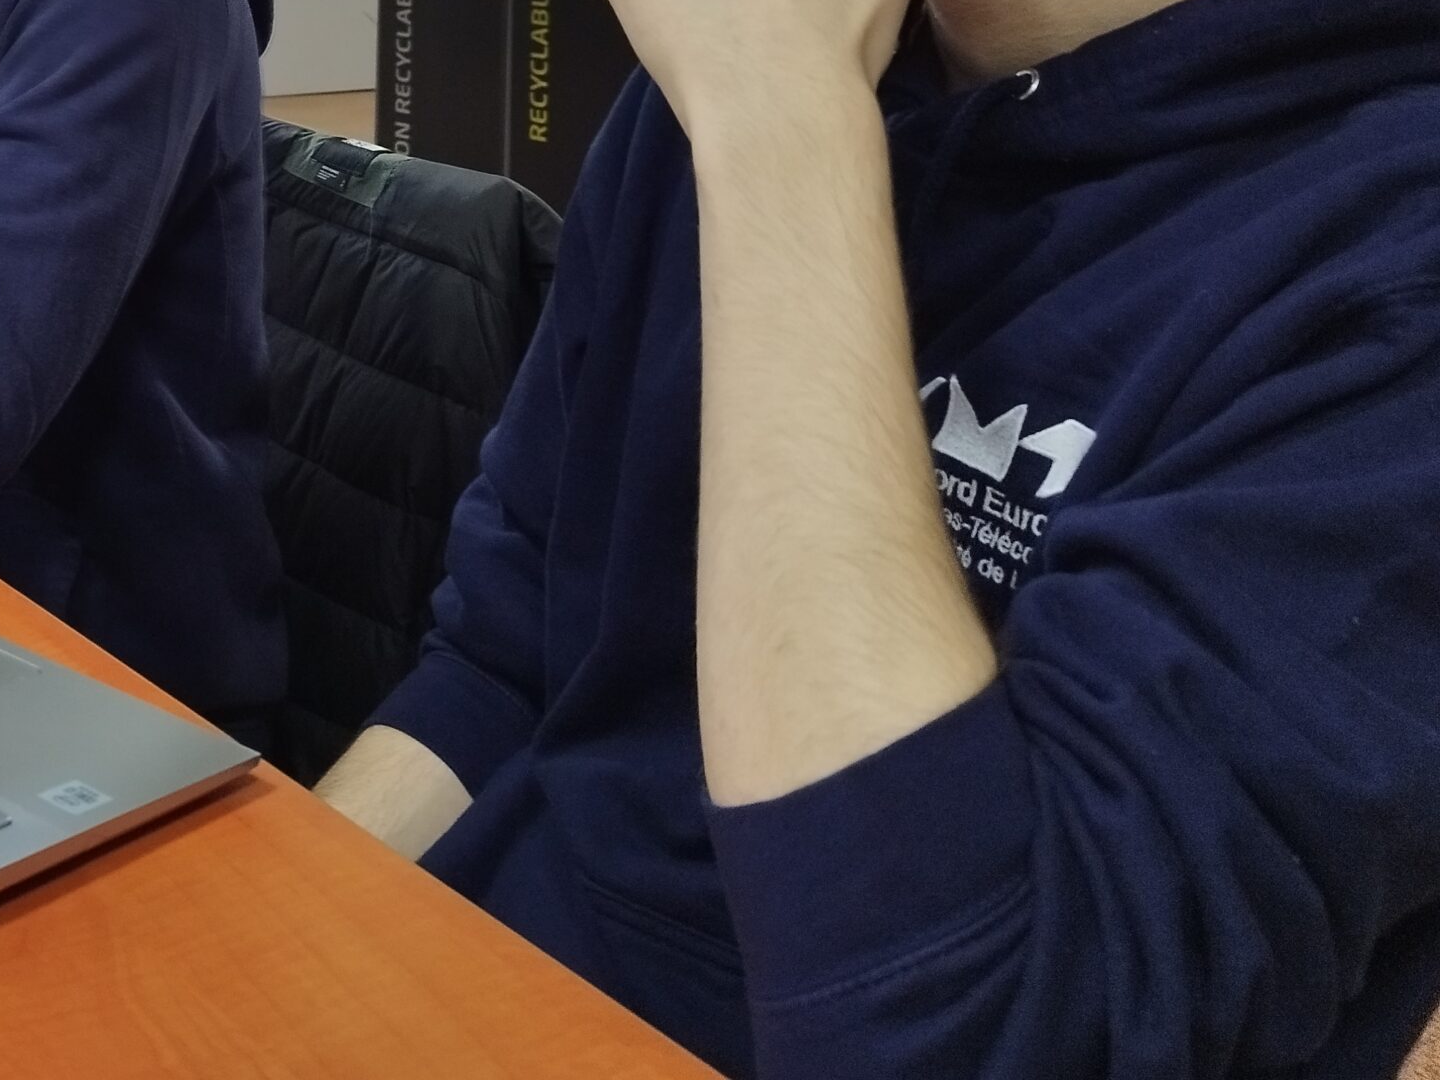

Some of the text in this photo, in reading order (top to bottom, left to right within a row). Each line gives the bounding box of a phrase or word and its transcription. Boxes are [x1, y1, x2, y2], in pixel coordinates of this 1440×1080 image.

[394, 121, 410, 156] ON
[934, 468, 1048, 537] ord Euro
[977, 557, 1004, 585] de
